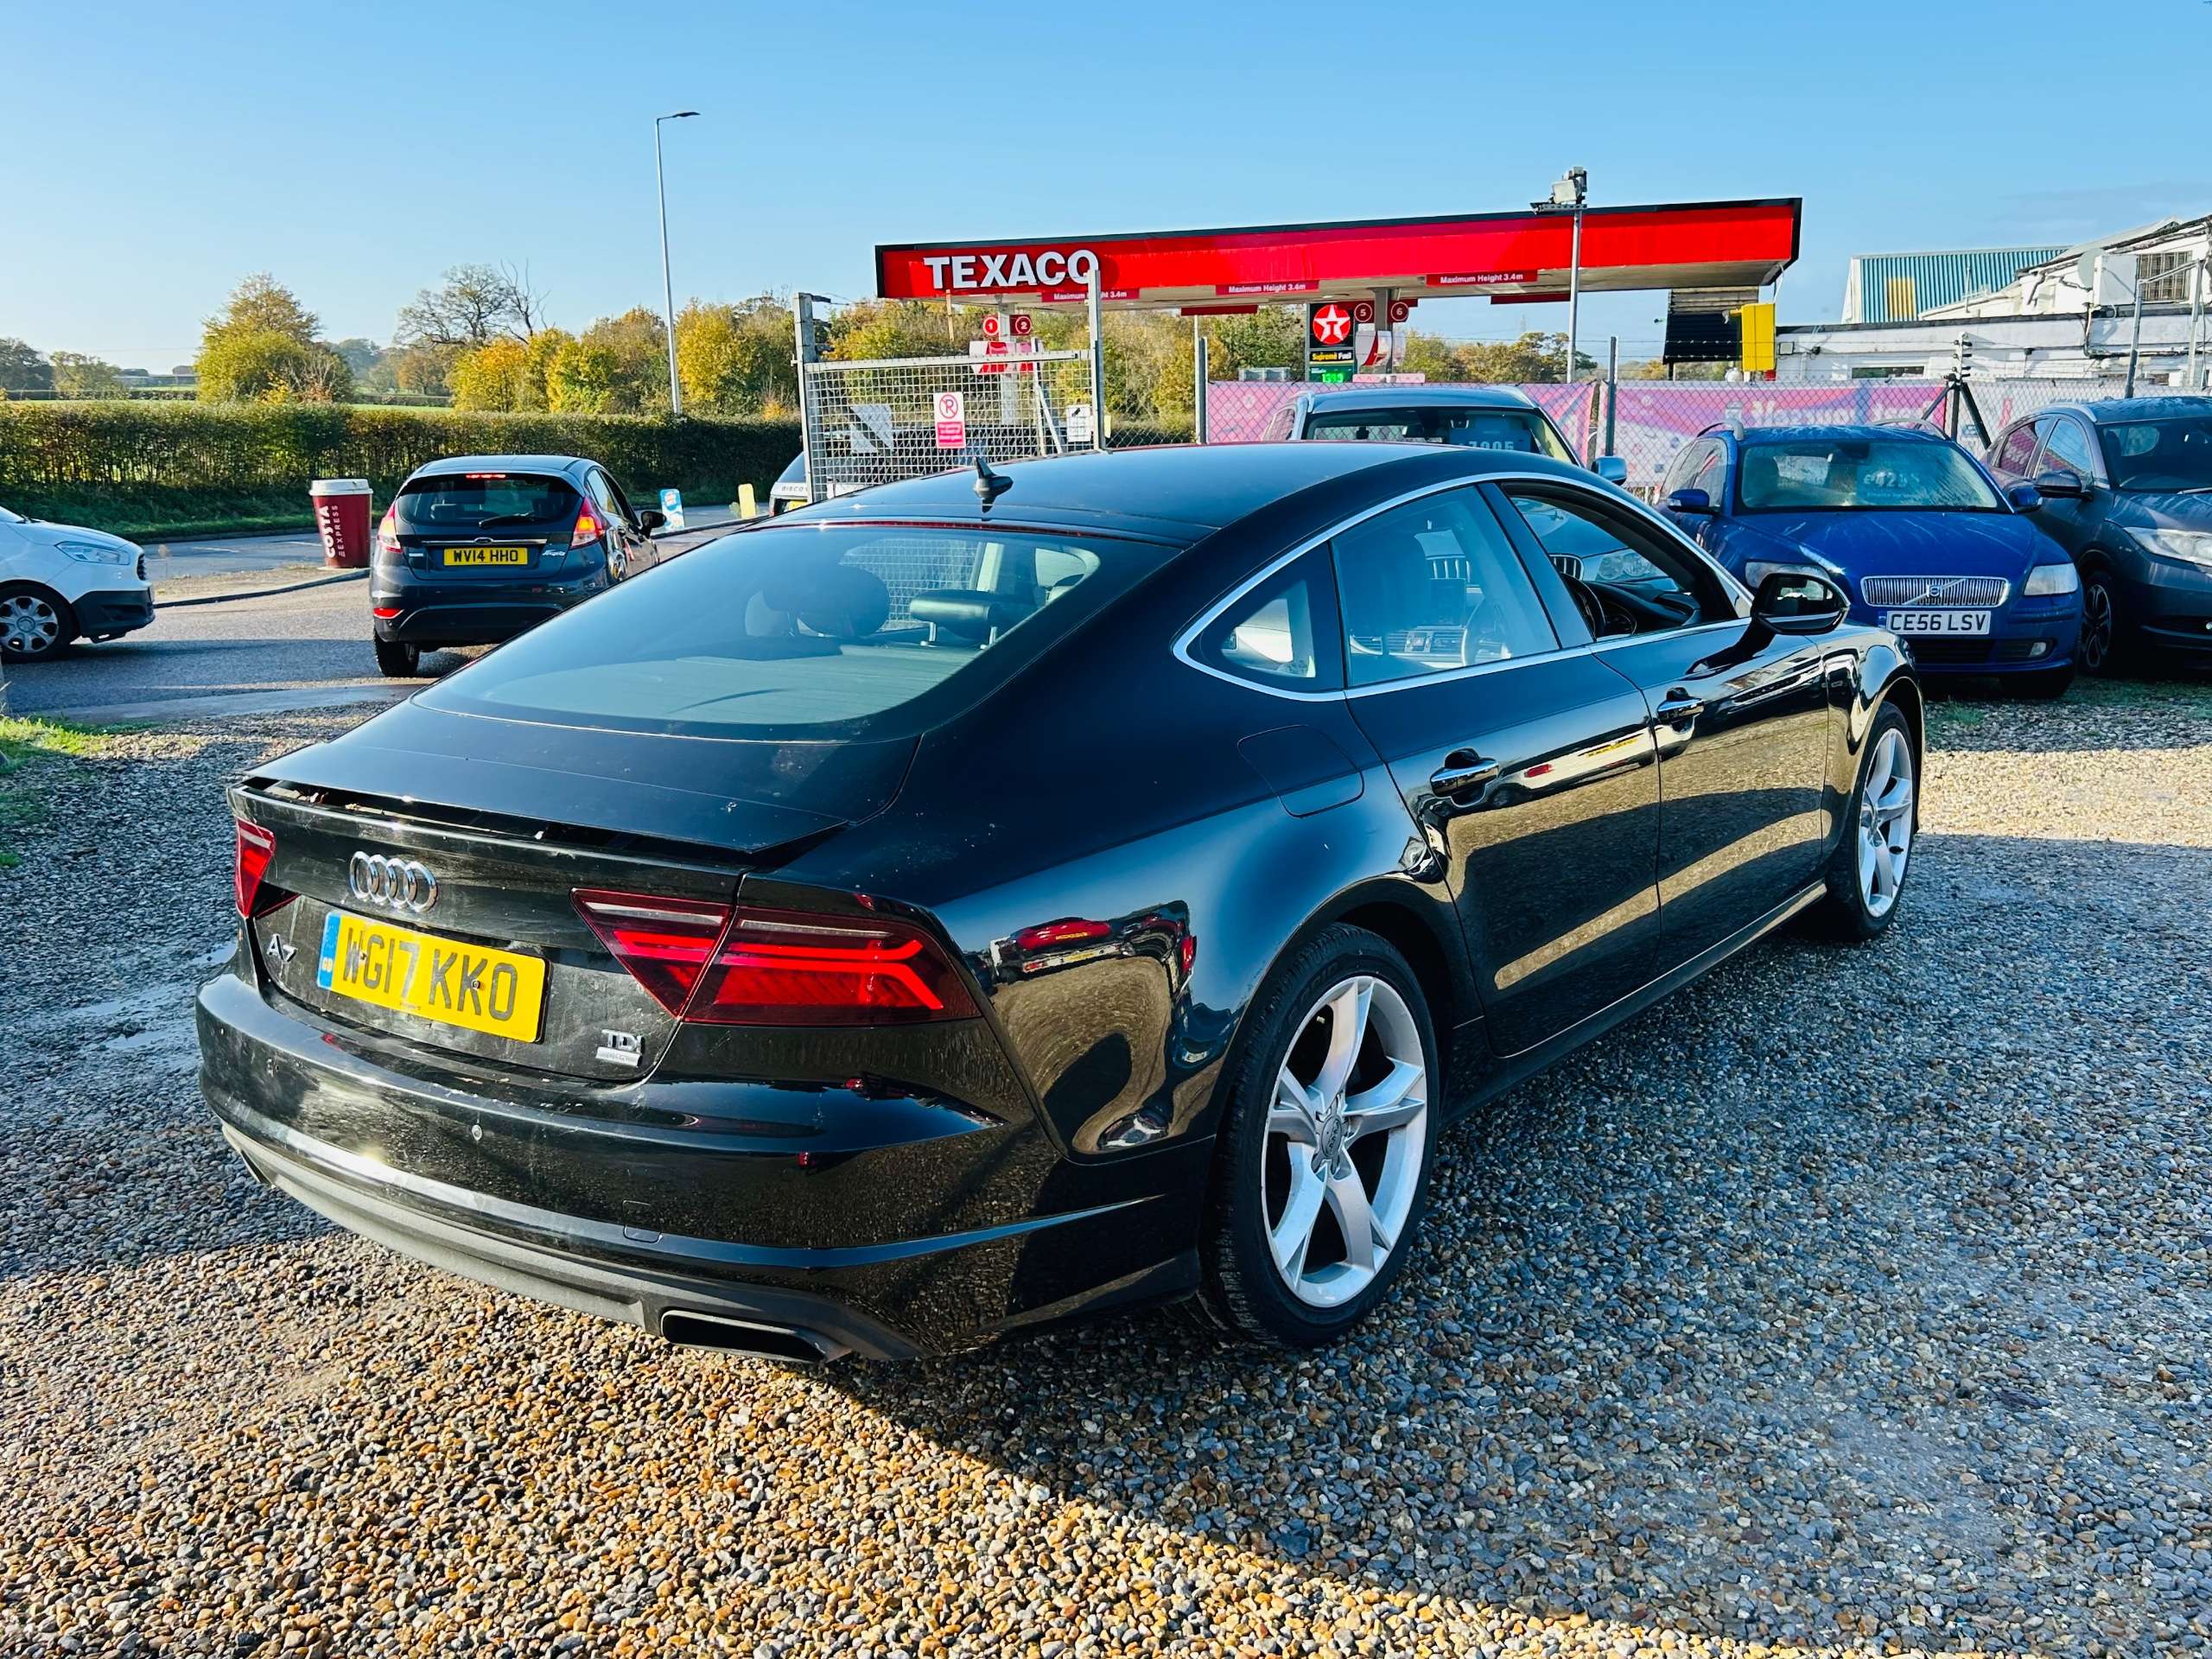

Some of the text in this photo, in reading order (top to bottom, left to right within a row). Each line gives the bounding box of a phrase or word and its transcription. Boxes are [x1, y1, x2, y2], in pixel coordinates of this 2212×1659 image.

[924, 250, 1099, 289] TEXACO
[1478, 274, 1502, 283] Height
[1503, 273, 1523, 282] 3.4m
[1053, 292, 1086, 301] Maximum
[1109, 289, 1128, 298] 3.4m
[1228, 283, 1306, 294] Maximum Height 3.4m
[1359, 308, 1367, 317] 5
[1020, 321, 1028, 330] 2
[318, 505, 336, 558] COSTA
[331, 505, 345, 550] EXPRESS
[453, 550, 519, 563] WV14 HHO
[1890, 613, 1987, 632] CE56 LSV
[266, 934, 298, 963] A7
[343, 927, 518, 1021] WG17 KKO
